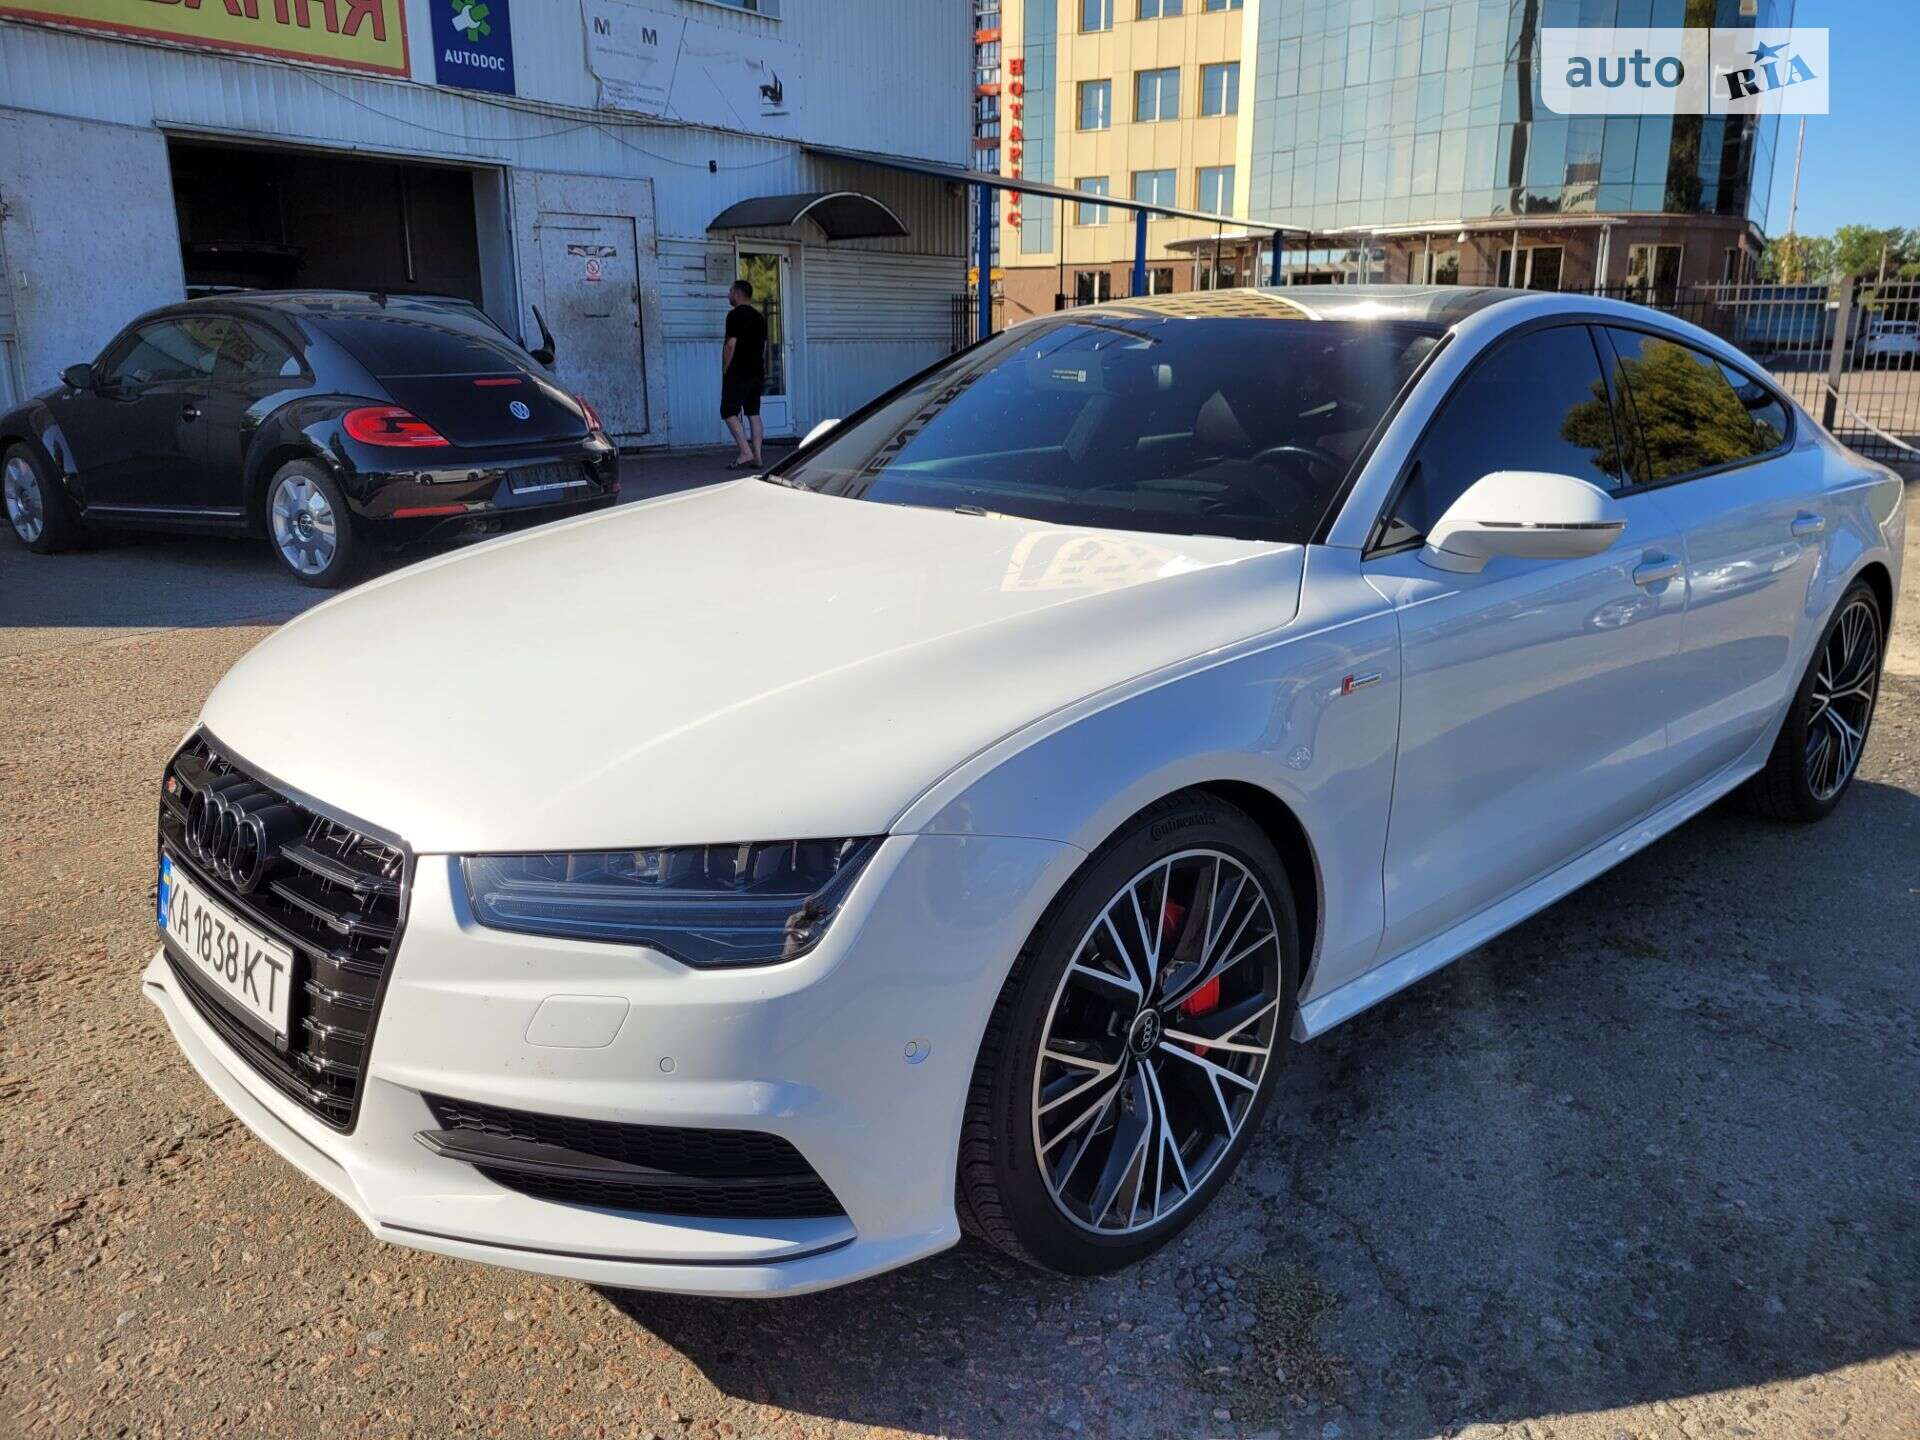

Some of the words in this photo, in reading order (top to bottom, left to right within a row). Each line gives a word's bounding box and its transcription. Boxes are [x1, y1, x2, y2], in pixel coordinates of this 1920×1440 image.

[445, 49, 505, 71] AUTODOC
[194, 904, 239, 984] 1838
[243, 941, 284, 1012] KT
